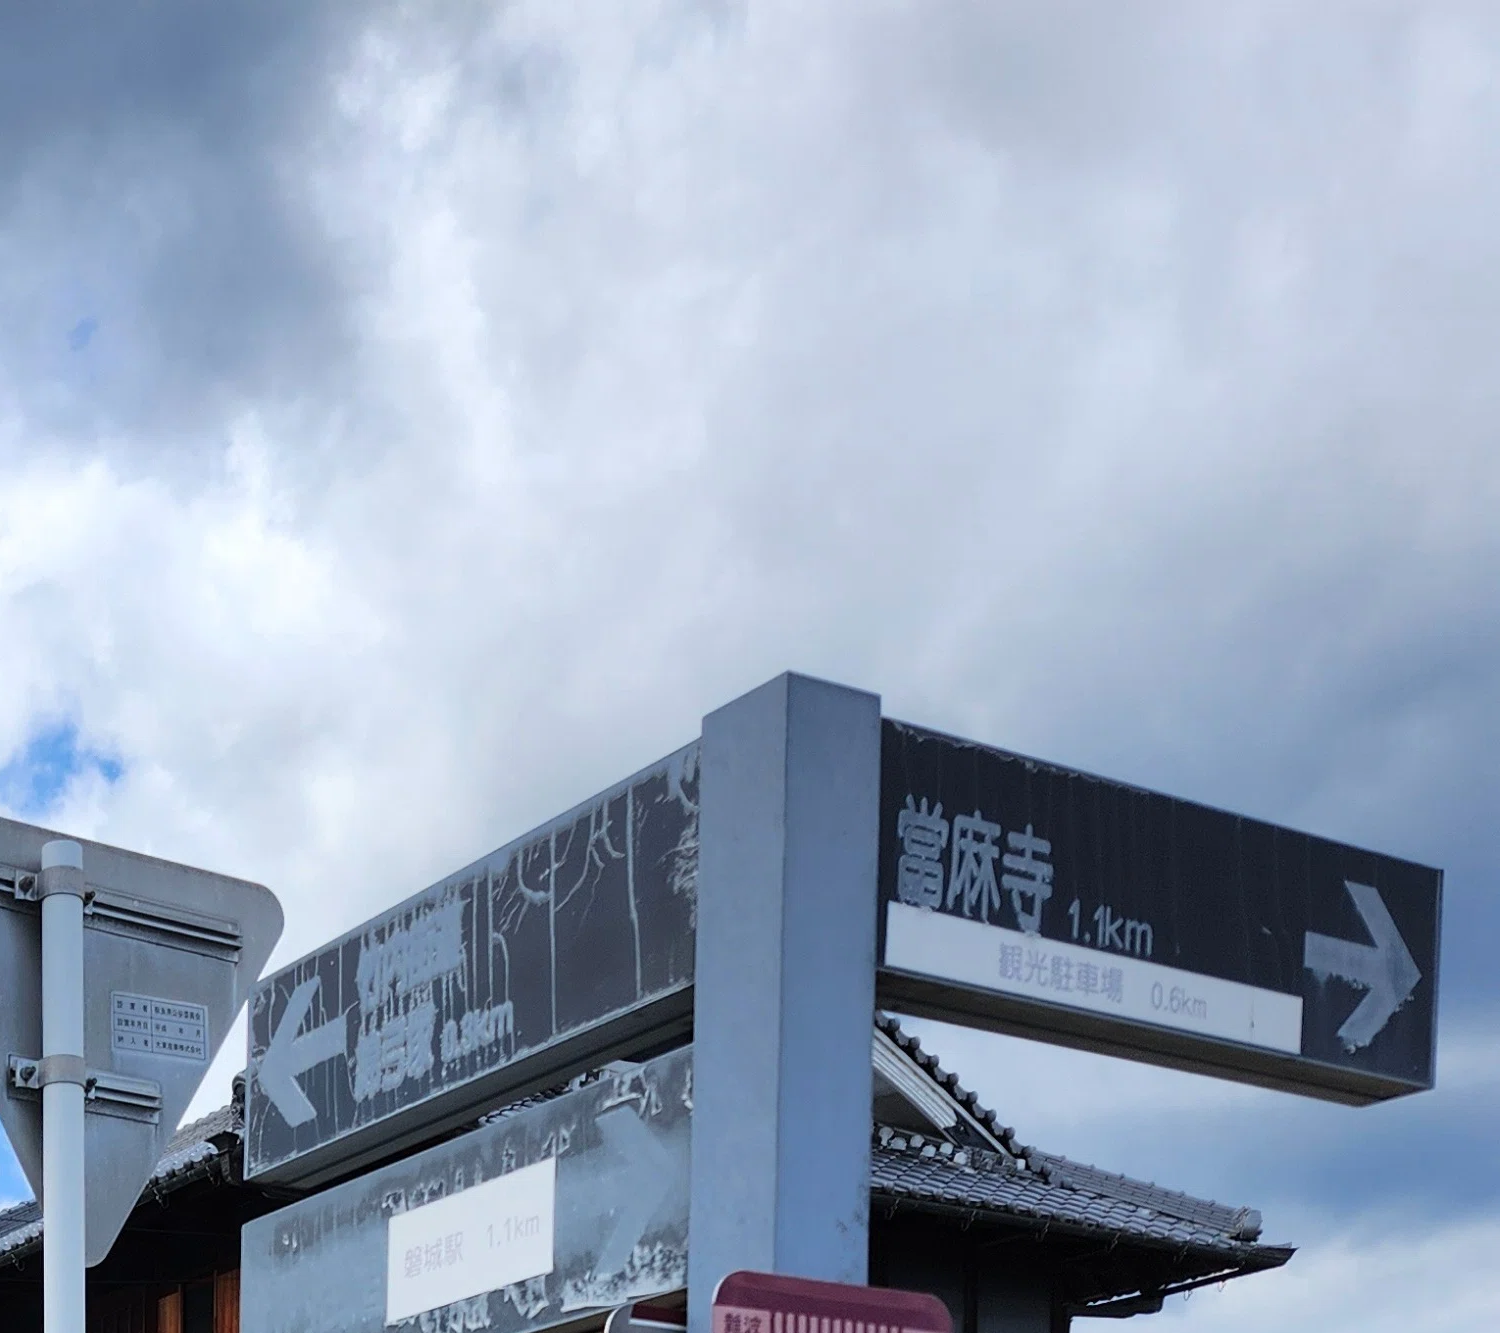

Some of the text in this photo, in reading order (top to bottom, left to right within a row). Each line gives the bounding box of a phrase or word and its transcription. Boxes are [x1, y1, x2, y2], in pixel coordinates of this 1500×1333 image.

[897, 792, 1154, 957] 當麻寺 1.1km
[998, 941, 1208, 1020] 観光駐車場 0.6km
[486, 1214, 541, 1250] 1.1km
